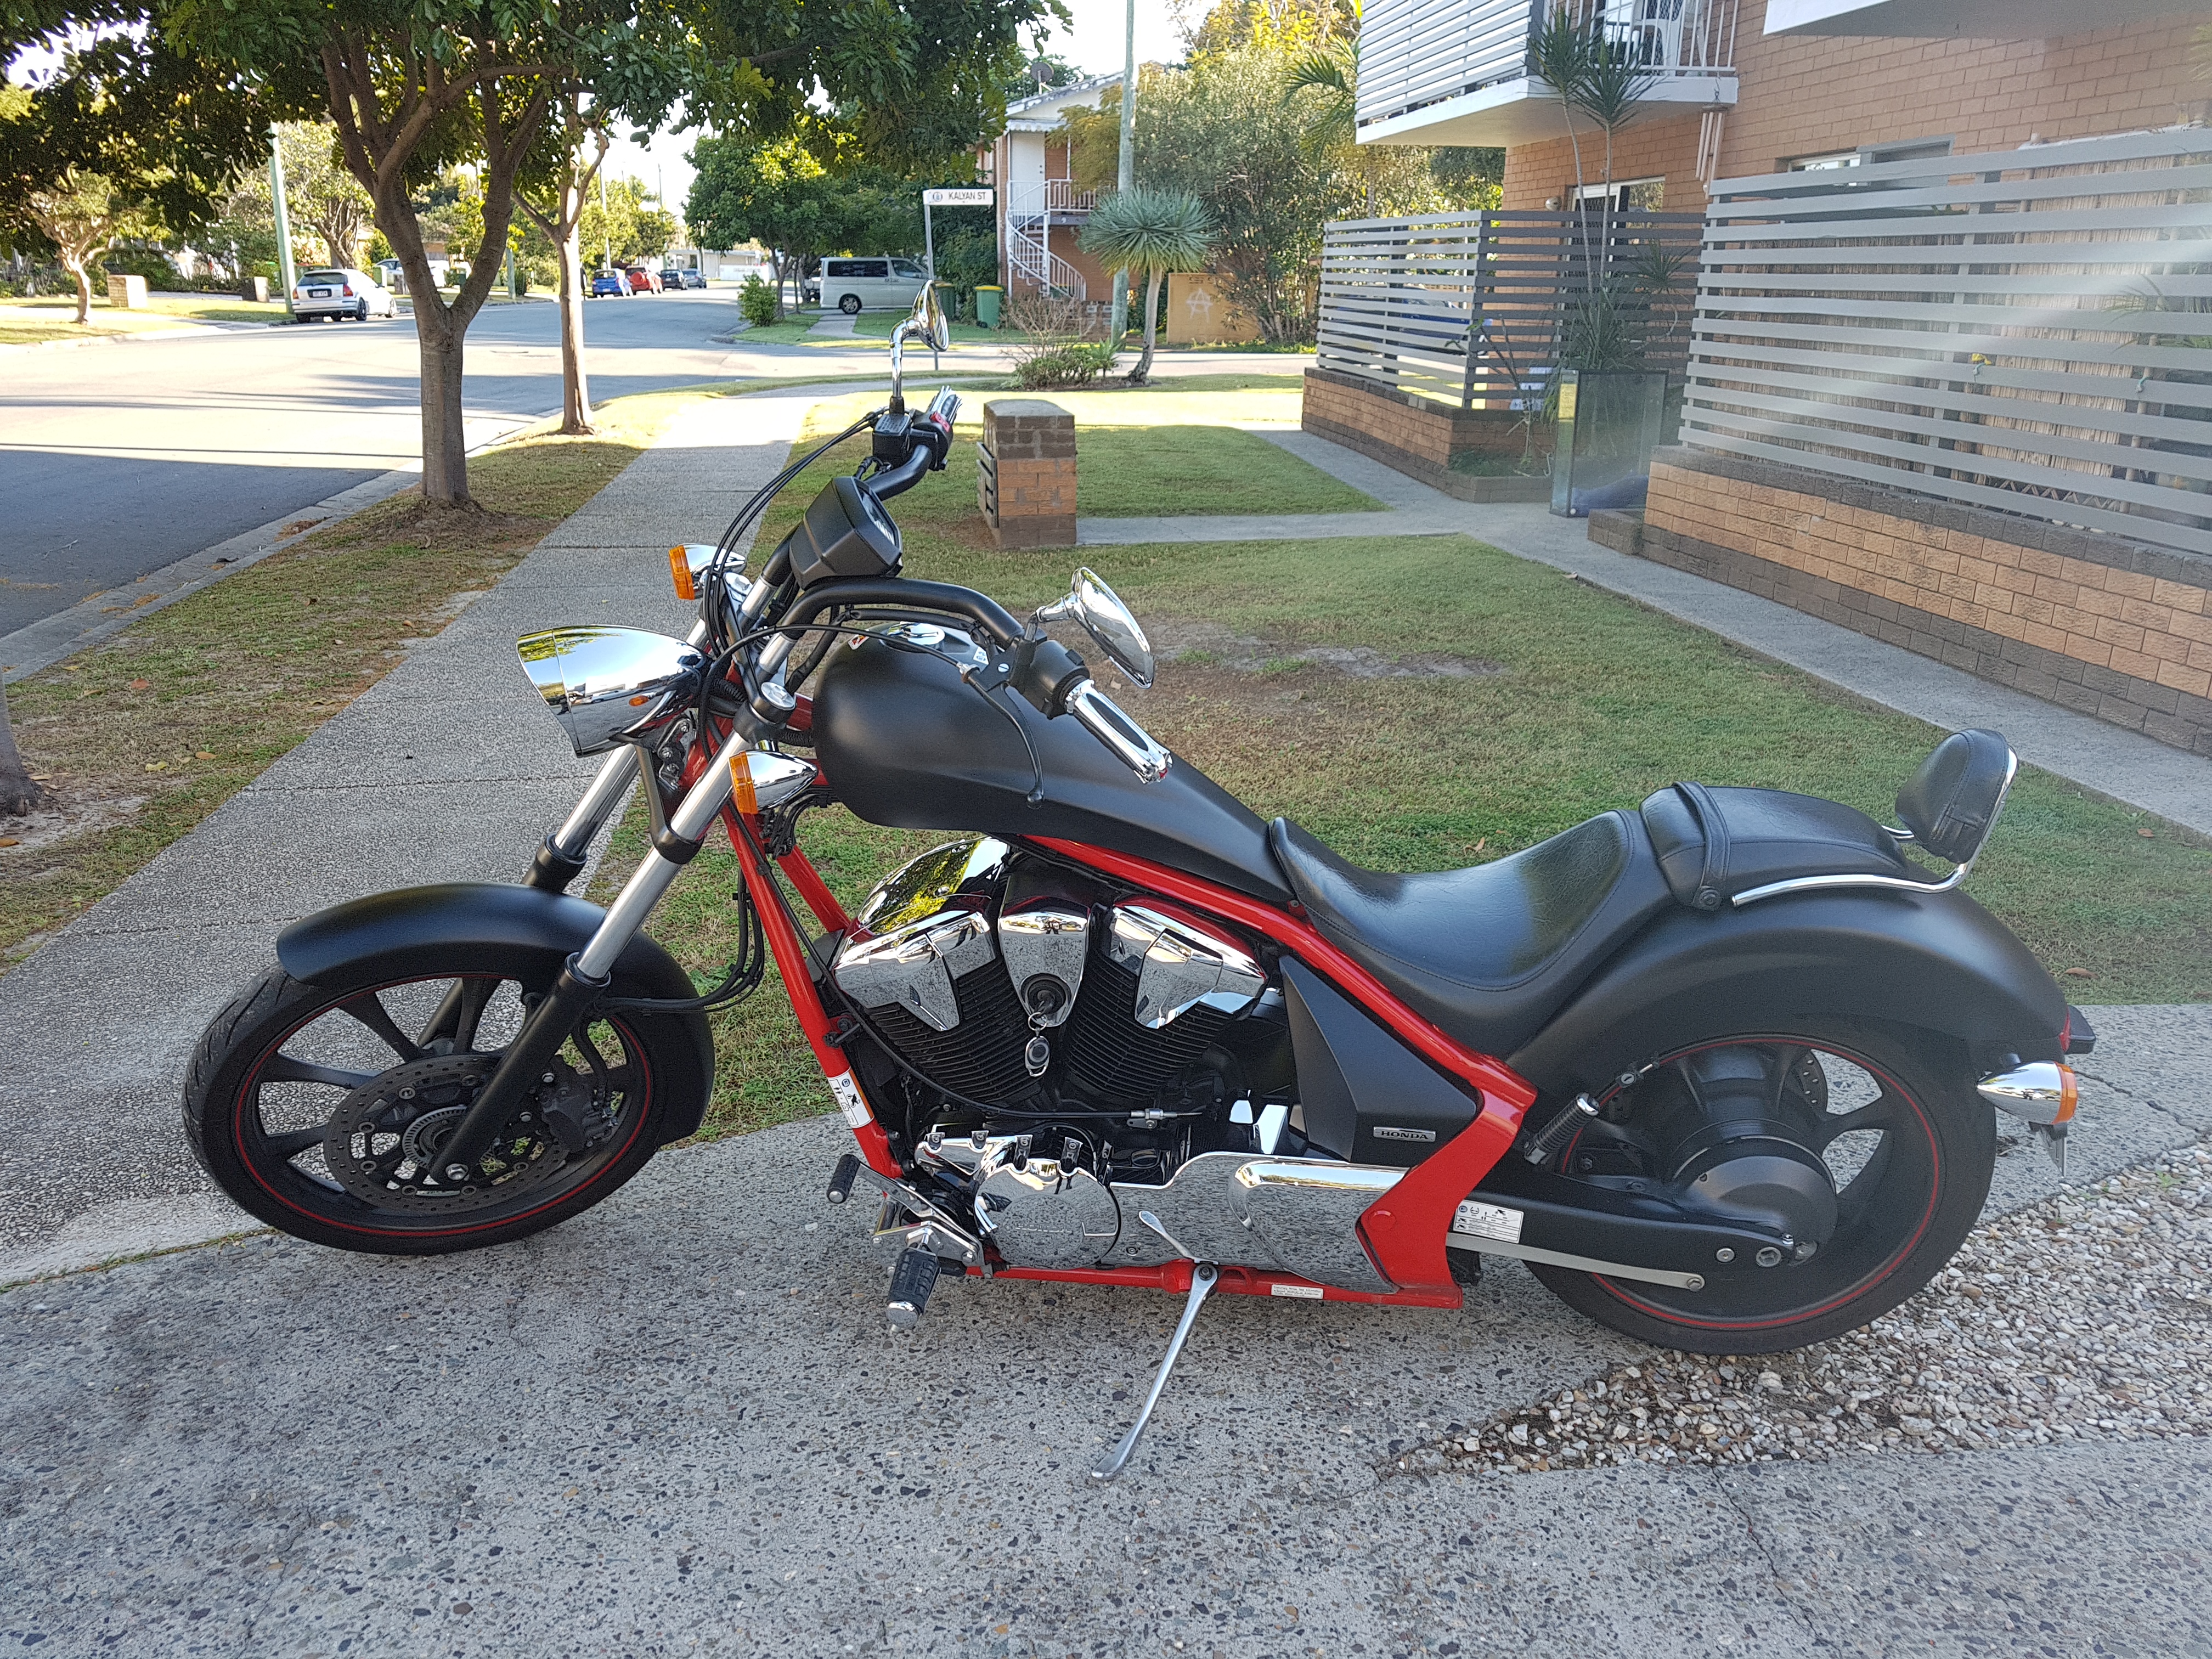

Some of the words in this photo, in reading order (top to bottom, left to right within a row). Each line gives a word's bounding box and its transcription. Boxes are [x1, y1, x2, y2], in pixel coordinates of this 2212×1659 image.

[949, 191, 975, 200] KALYAN
[978, 191, 986, 200] ST
[1381, 1131, 1429, 1139] HONDA
